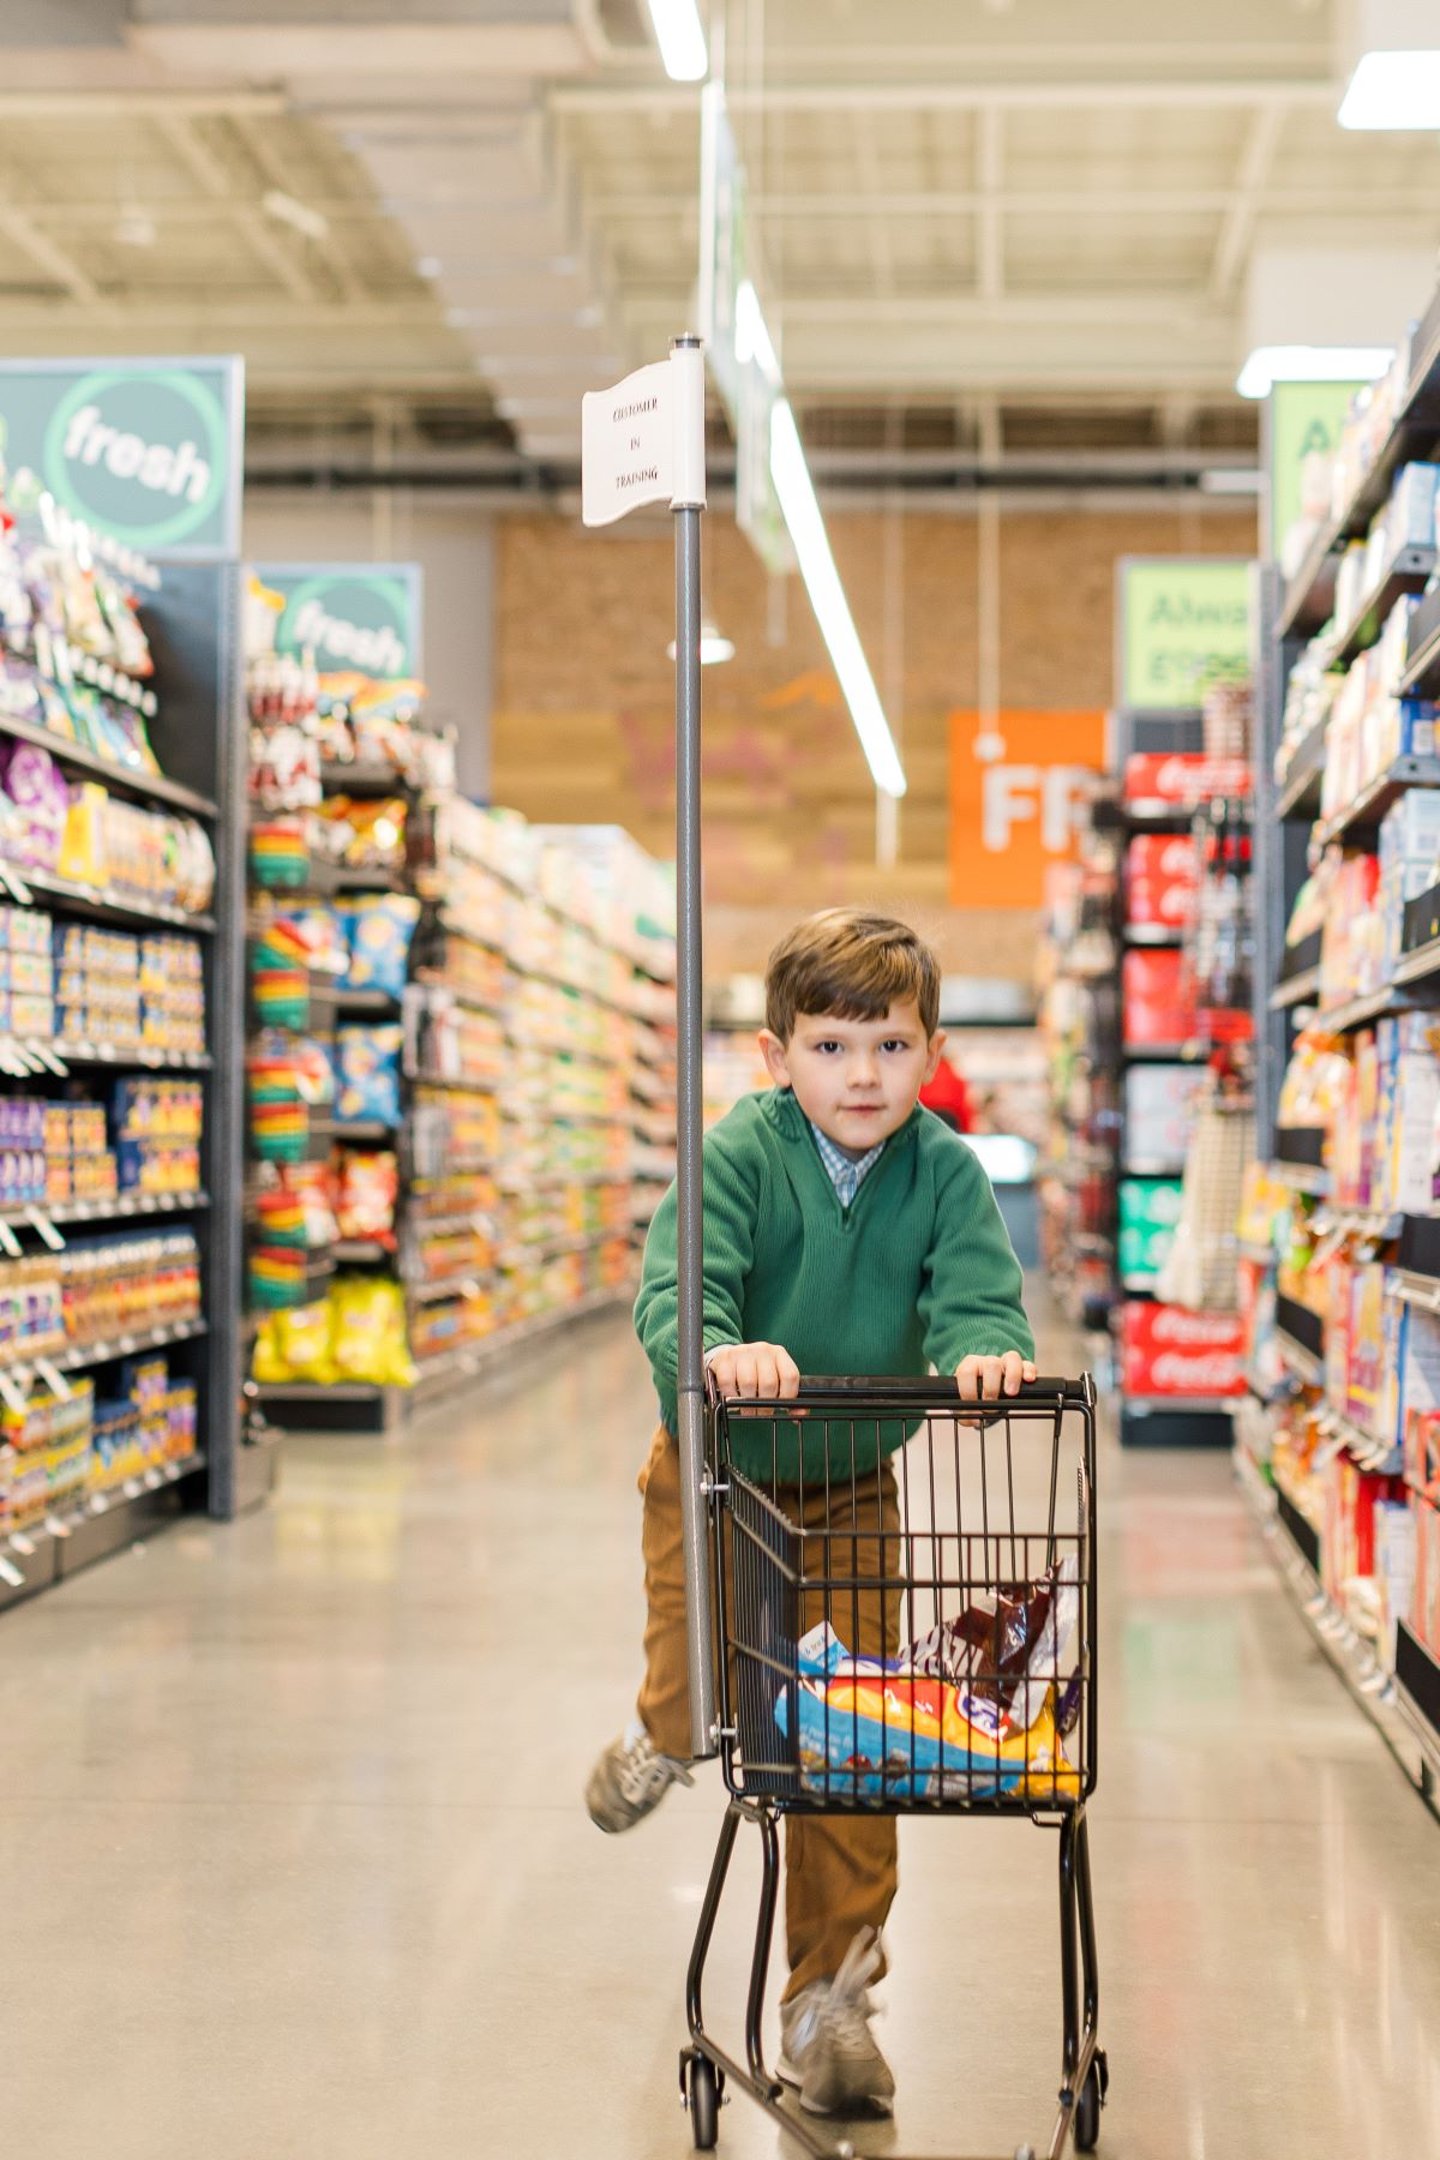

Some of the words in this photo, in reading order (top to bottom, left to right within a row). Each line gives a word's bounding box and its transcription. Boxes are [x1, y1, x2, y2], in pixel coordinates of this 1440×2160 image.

[613, 398, 658, 422] CUSTOMER
[63, 403, 212, 504] fresh
[630, 437, 641, 451] IN
[616, 468, 658, 489] TRAINING
[293, 598, 406, 673] fresh
